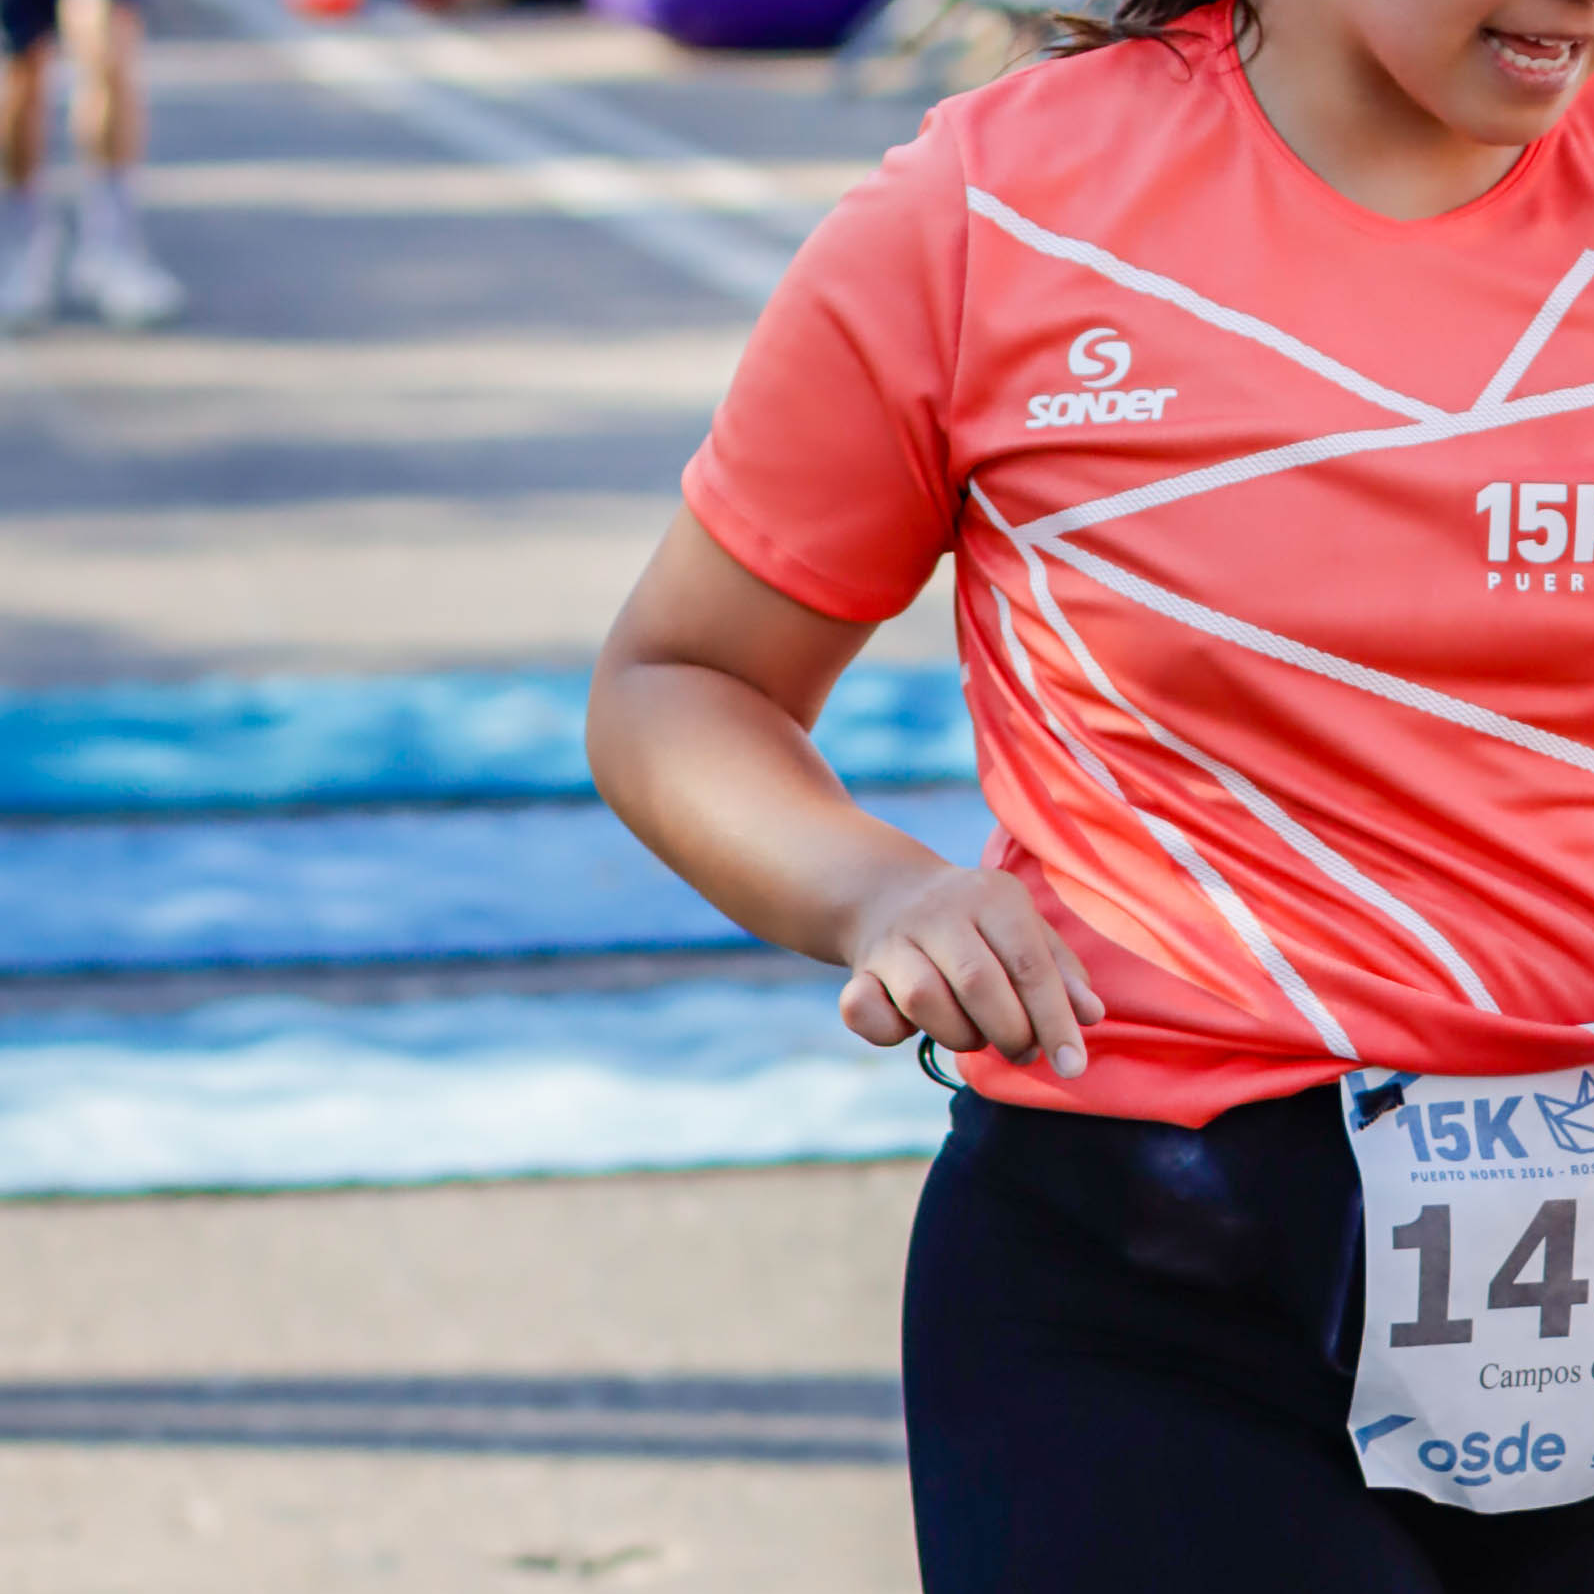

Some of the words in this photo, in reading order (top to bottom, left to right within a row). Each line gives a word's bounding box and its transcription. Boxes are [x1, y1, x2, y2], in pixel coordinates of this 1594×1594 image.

[1395, 1095, 1529, 1163] 15K
[1411, 1169, 1465, 1183] PUERTO
[1470, 1168, 1515, 1180] NORTE
[1479, 1363, 1581, 1392] Campos
[1418, 1421, 1567, 1475] osde
